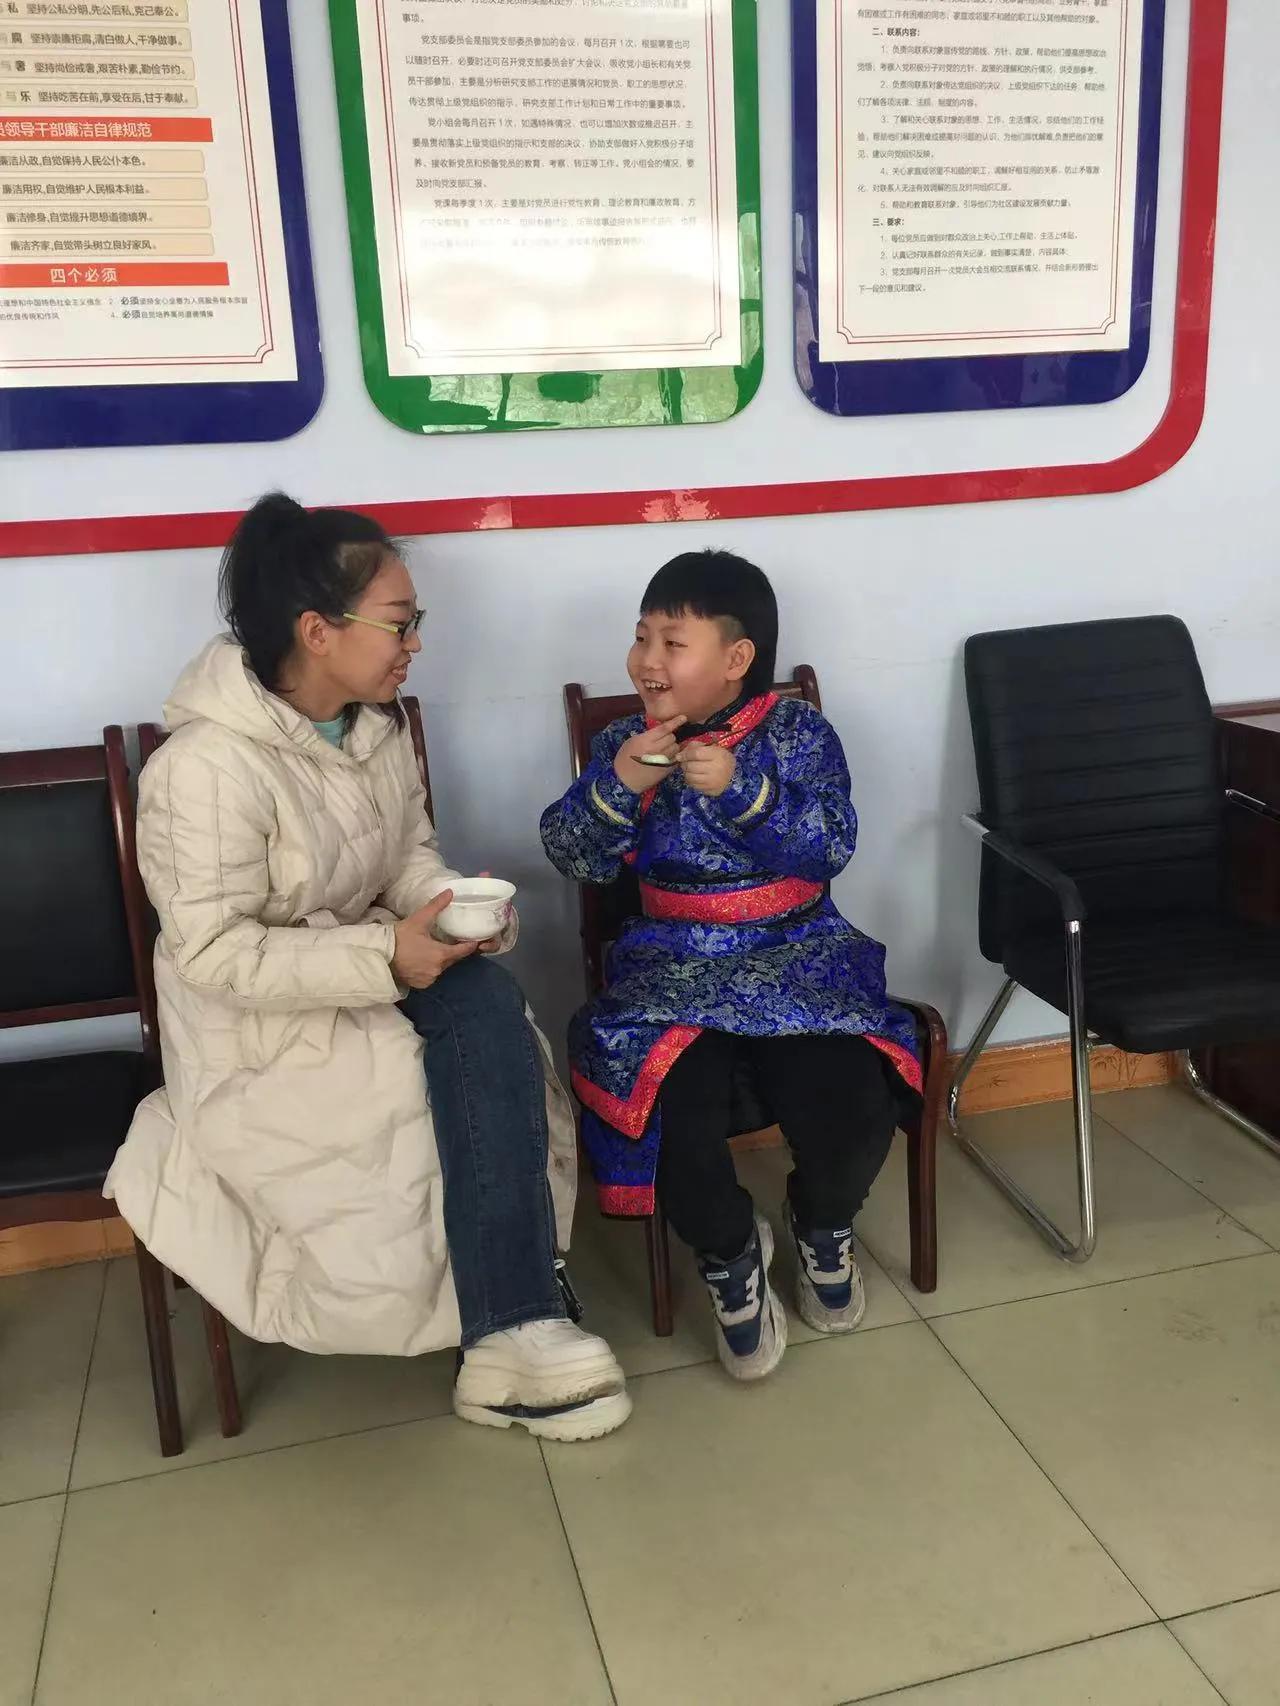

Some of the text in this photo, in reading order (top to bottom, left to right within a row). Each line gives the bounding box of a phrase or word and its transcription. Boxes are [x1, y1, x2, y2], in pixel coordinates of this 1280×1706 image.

[7, 2, 19, 14] 私
[20, 90, 32, 102] 乐
[50, 267, 118, 283] 四个必须
